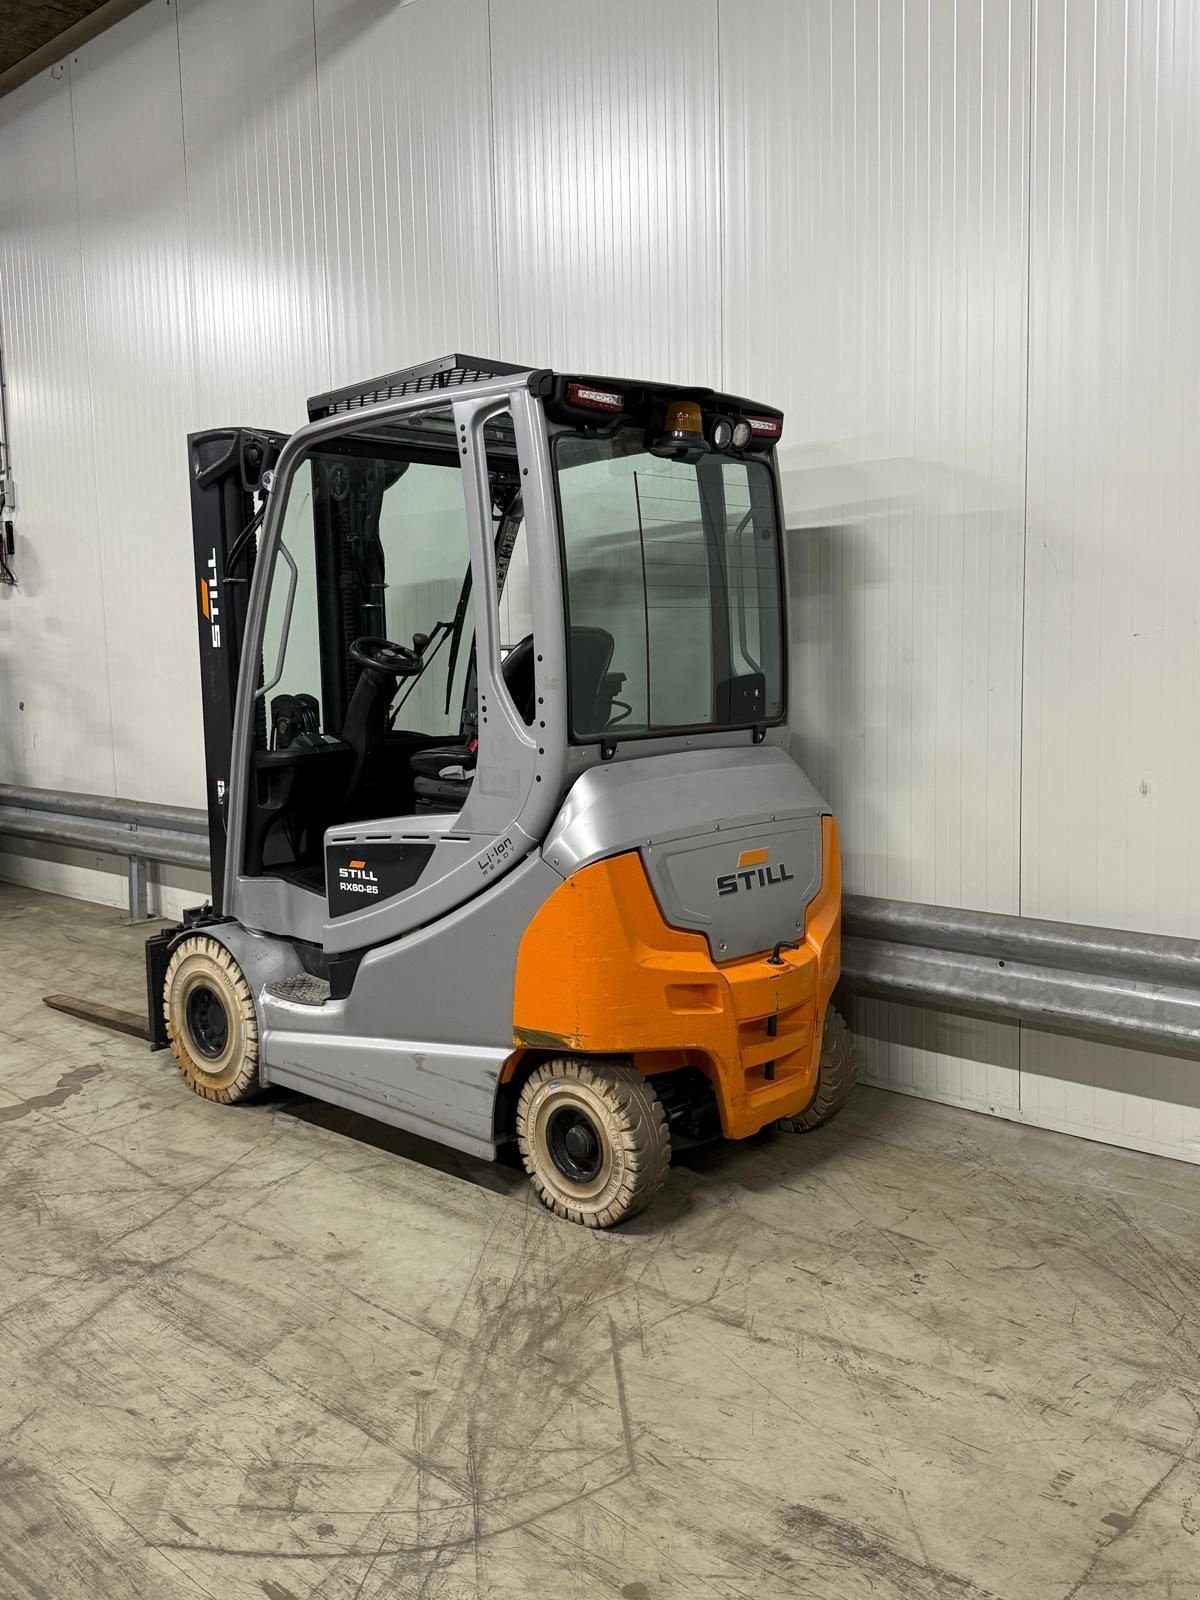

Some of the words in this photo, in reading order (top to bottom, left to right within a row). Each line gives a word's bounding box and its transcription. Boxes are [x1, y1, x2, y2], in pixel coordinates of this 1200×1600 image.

[207, 547, 221, 648] STILL
[478, 838, 512, 869] Li-Ion
[482, 845, 515, 877] READY
[338, 867, 378, 882] STILL
[339, 882, 379, 894] RX60-25
[716, 862, 795, 896] STILL
